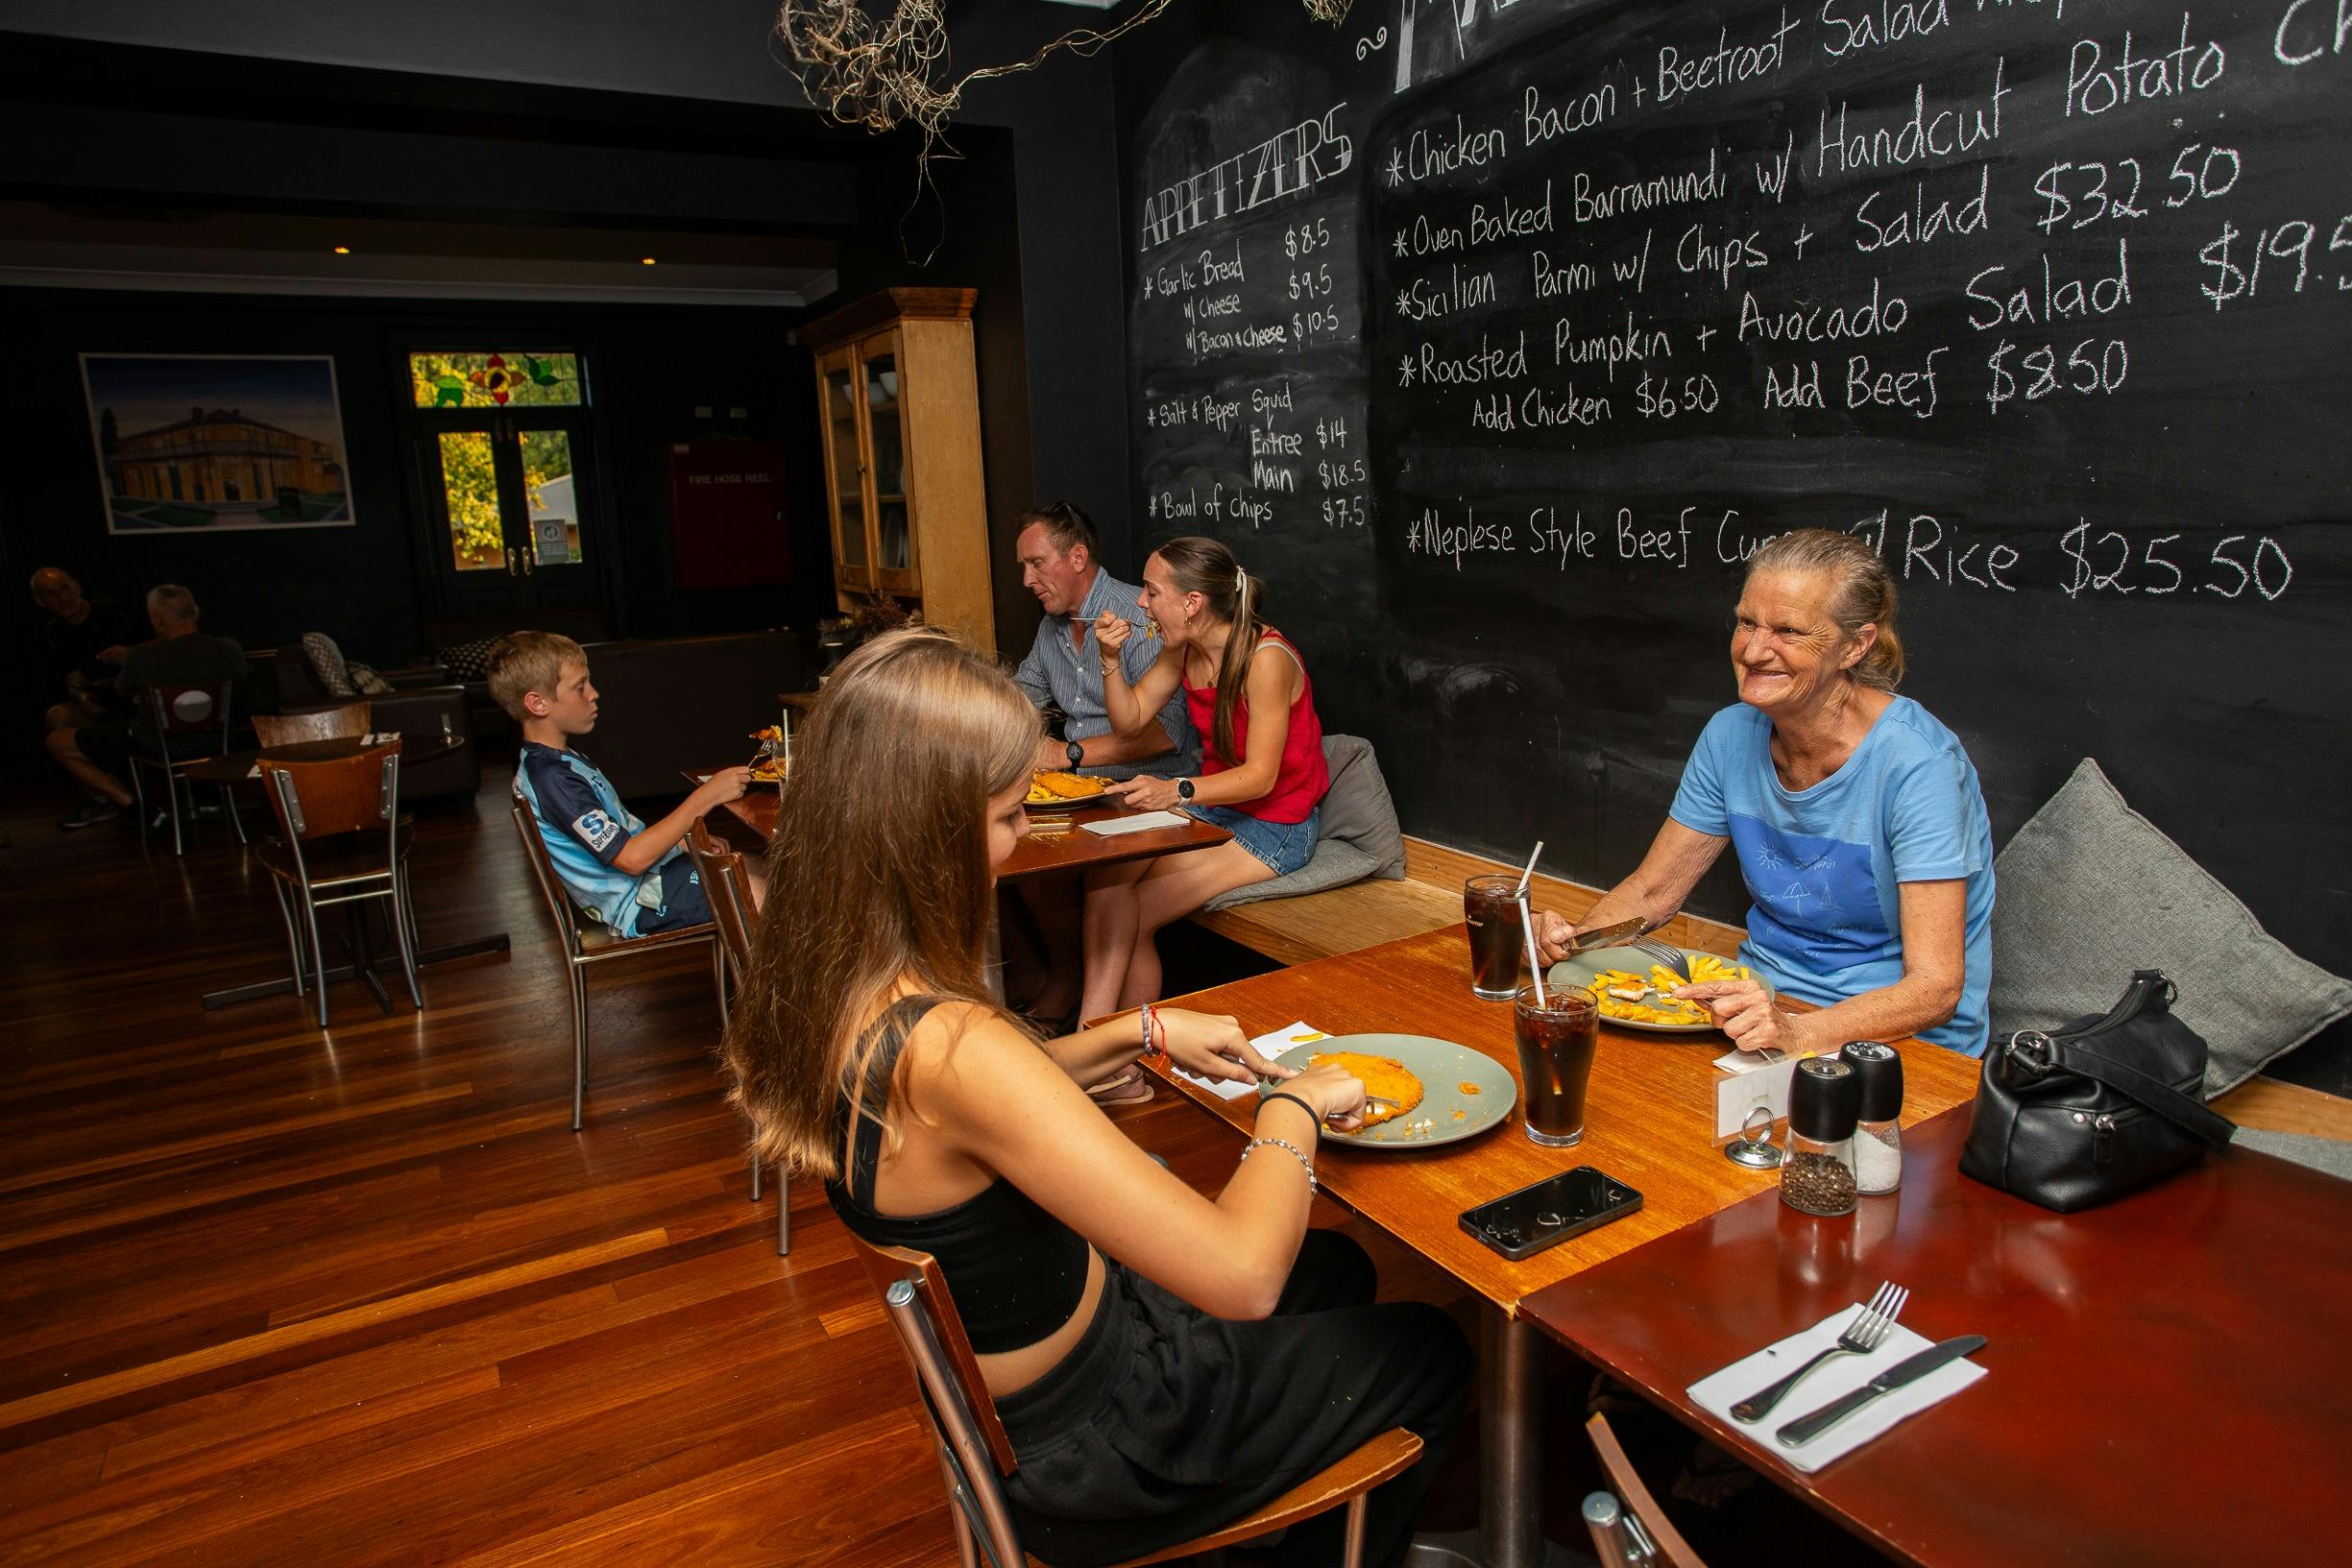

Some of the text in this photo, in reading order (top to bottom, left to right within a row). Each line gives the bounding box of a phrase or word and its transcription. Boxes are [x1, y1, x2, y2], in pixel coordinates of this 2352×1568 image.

[1410, 0, 1949, 180] Chicken Bacon + Beetroot Salad
[1415, 215, 1464, 254] Oven
[1471, 180, 1554, 246] Baked
[1575, 148, 1726, 222] Barramundi
[1756, 130, 1792, 204] w/
[1818, 56, 2011, 177] Handcut
[2066, 12, 2224, 116] Potato
[1158, 218, 1329, 295] Garlic Bread $8.5
[1412, 263, 1495, 321] Sicilian
[1533, 251, 1594, 299] Parmi
[1613, 229, 1652, 292] w/
[1677, 224, 1768, 290] Chips
[1794, 224, 1813, 260] +
[1856, 164, 1987, 252] Salad
[1200, 294, 1241, 318] Cheese
[1290, 263, 1331, 300] $9.5
[1294, 304, 1338, 341] $10.5
[1421, 330, 1527, 383] Roasted
[1556, 311, 1671, 382] Pumpkin
[1696, 326, 1716, 351] +
[1738, 277, 1907, 342] Avocado
[1966, 238, 2131, 330] Salad
[1160, 399, 1187, 426] Salt
[1201, 396, 1241, 432] Pepper
[1252, 382, 1293, 430] Squid
[1472, 394, 1515, 431] Add
[1521, 381, 1612, 426] Chicken
[1763, 361, 1826, 409] Add
[1847, 347, 1949, 418] Beef
[1250, 417, 1346, 457] Entree $14
[689, 473, 771, 485] FIRE HOSE REEL
[1161, 489, 1196, 519] Bowl
[1205, 483, 1222, 521] of
[1322, 496, 1364, 527] $7.5
[1254, 459, 1365, 492] Main $18.5
[1424, 506, 1515, 571] Neplese
[1530, 507, 1595, 570] Style
[1617, 507, 1696, 567] Beef
[1904, 515, 2019, 591] Rice
[2060, 517, 2293, 600] $25.50
